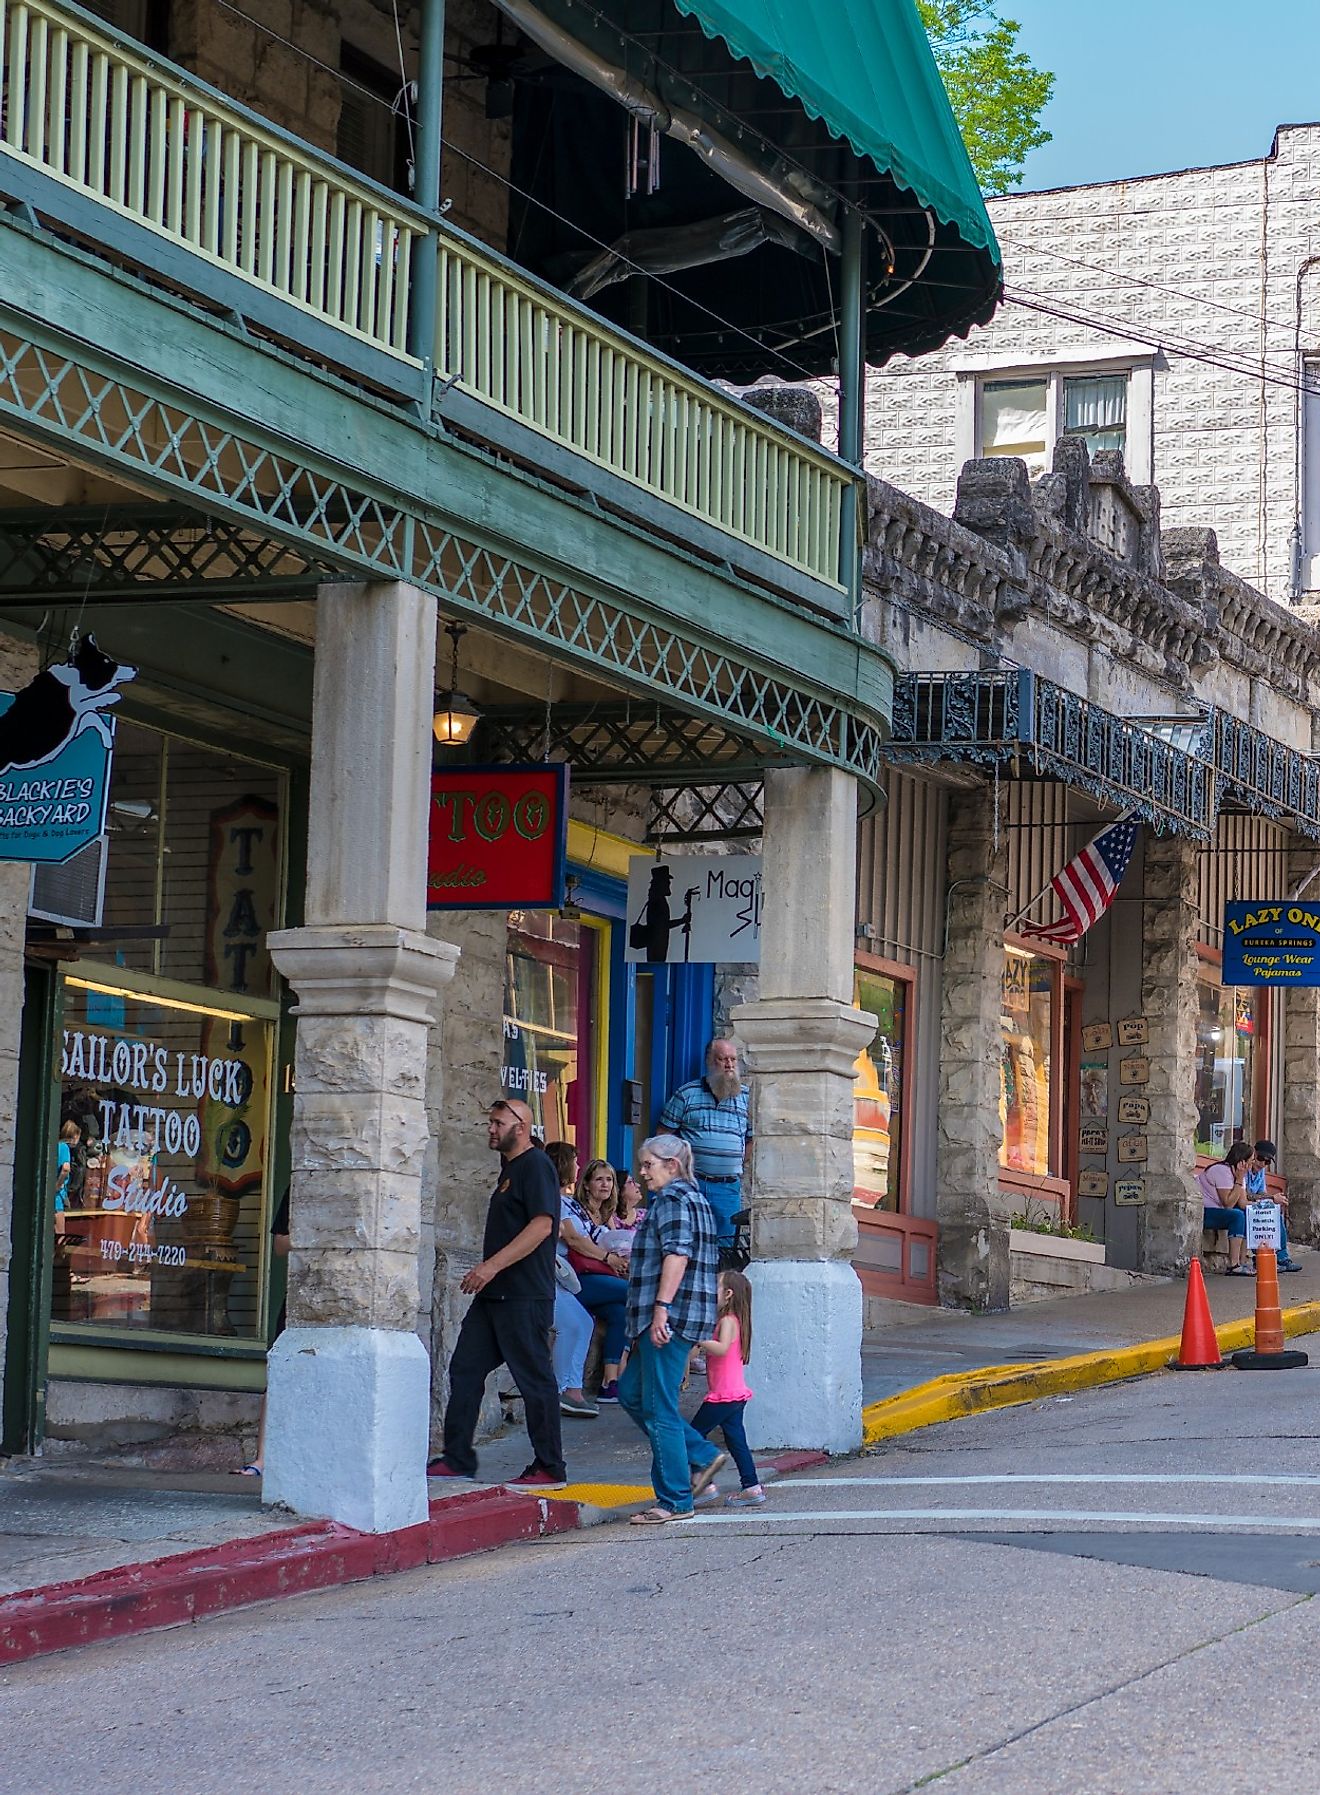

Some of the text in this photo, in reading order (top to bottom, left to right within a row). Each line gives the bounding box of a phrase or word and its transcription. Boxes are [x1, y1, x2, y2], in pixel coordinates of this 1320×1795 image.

[432, 790, 551, 843] TOO
[428, 863, 487, 889] udio
[1228, 907, 1284, 935] LAZY
[1278, 939, 1313, 947] SPRINGS
[1242, 953, 1315, 966] Lounge Wear
[1253, 967, 1302, 979] Pajamas
[175, 1051, 242, 1105] LUCK
[500, 1065, 547, 1093] VELTIES
[99, 1099, 201, 1158] TATTOO
[102, 1165, 188, 1218] Studio
[100, 1238, 186, 1267] 479-244-7220
